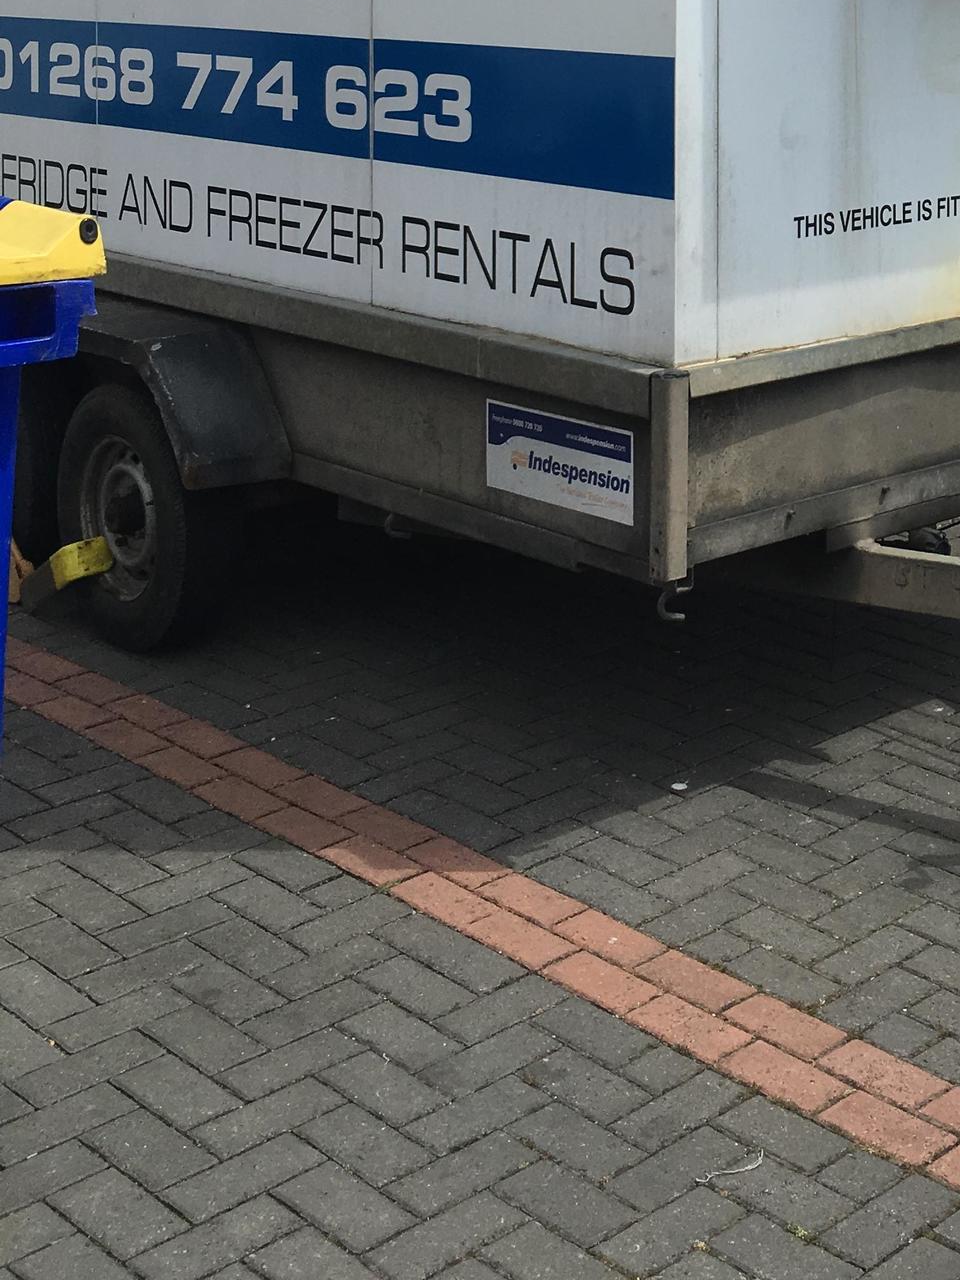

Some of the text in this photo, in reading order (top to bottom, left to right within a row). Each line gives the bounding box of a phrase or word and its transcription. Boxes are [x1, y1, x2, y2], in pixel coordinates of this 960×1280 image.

[175, 52, 298, 121] 774
[325, 65, 472, 143] 623
[119, 173, 193, 233] AND
[206, 187, 384, 269] FREEZER
[402, 216, 635, 316] RENTALS
[793, 212, 835, 239] THIS
[839, 201, 912, 233] VEHICLE
[916, 198, 933, 222] IS
[528, 450, 630, 494] Indespension
